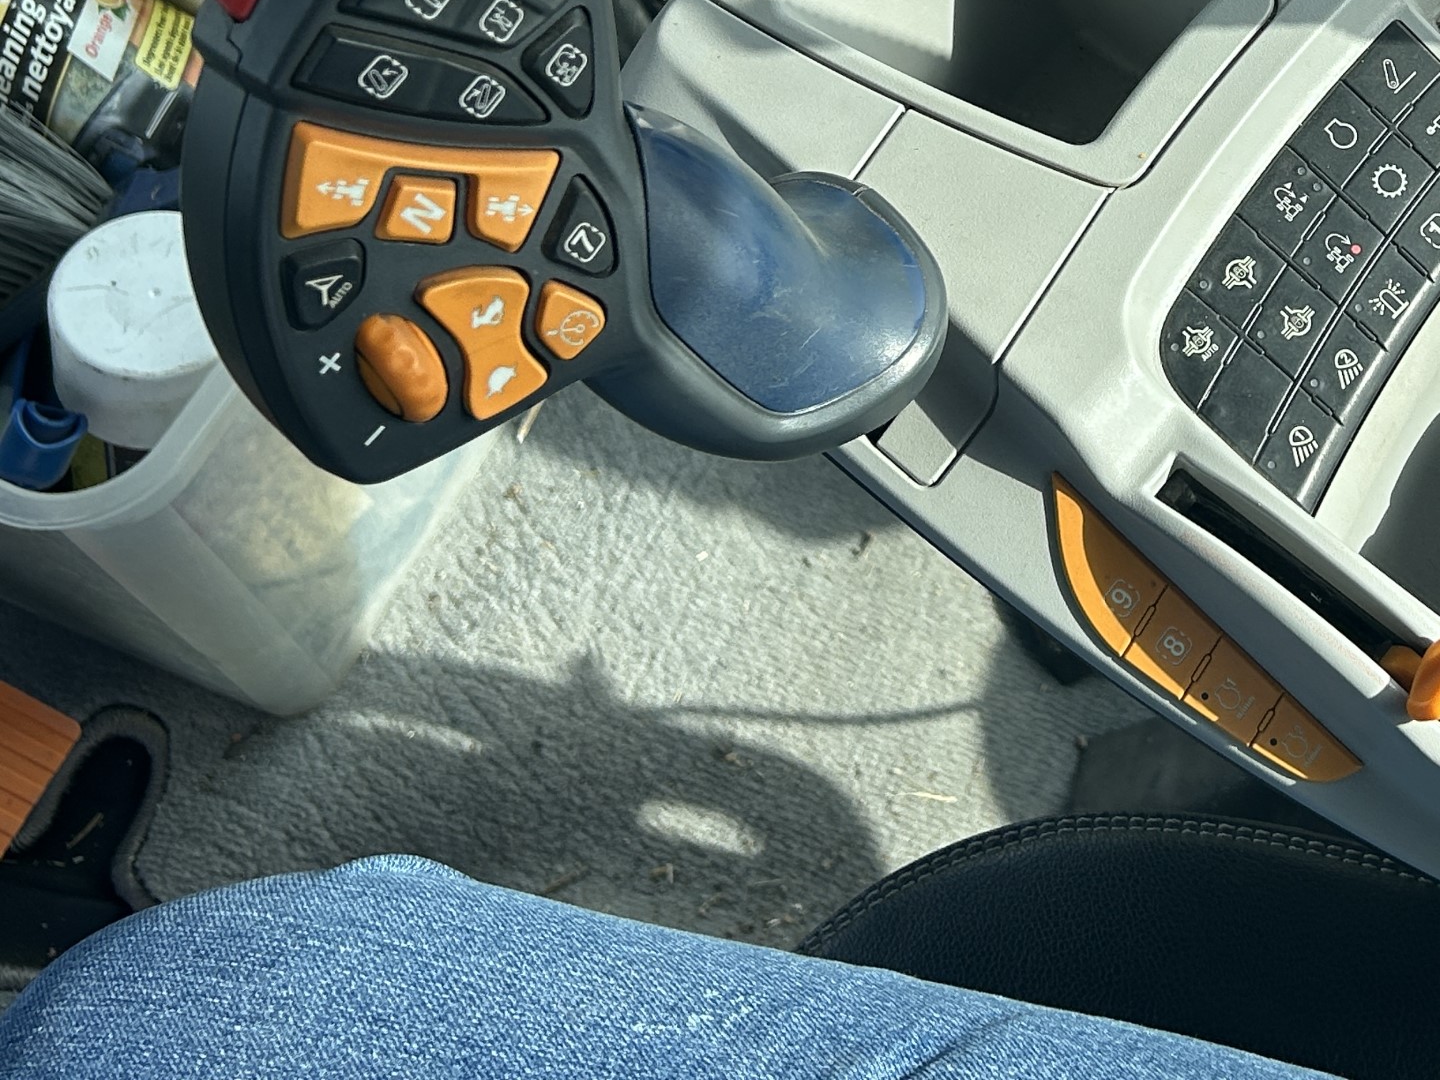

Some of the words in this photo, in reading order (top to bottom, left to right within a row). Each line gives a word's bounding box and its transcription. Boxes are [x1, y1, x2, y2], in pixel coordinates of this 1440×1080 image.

[85, 13, 113, 59] Orange
[401, 193, 447, 235] N
[570, 229, 594, 253] 7
[329, 281, 353, 309] AUTO
[1201, 343, 1220, 362] AUTO
[1111, 588, 1132, 609] 9
[1163, 635, 1185, 657] 8
